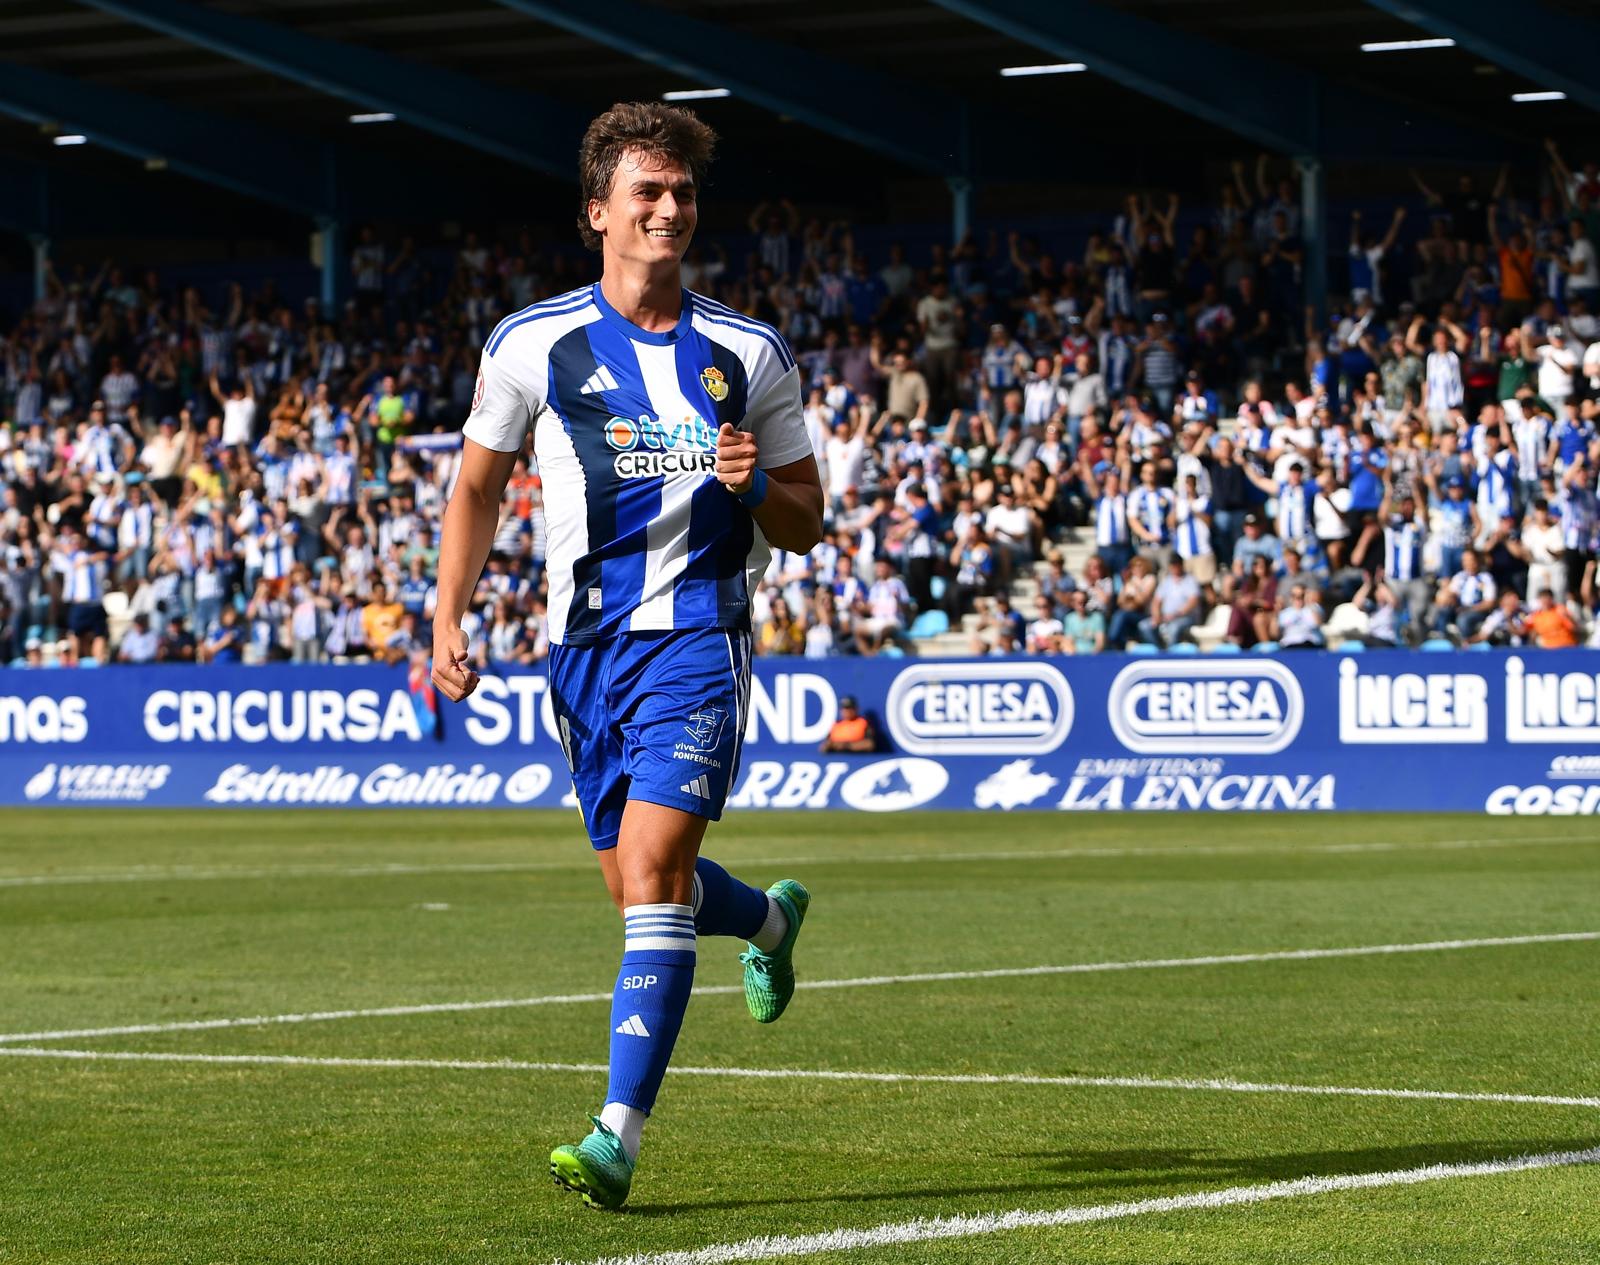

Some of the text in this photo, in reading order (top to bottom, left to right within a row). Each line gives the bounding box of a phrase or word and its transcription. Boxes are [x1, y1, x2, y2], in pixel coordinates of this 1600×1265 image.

[144, 689, 422, 743] CRICURSA
[673, 751, 721, 769] PONFERRADA
[204, 763, 502, 804] Estrella Galicia
[1057, 774, 1336, 811] LA ENCINA
[622, 974, 658, 990] SDP
